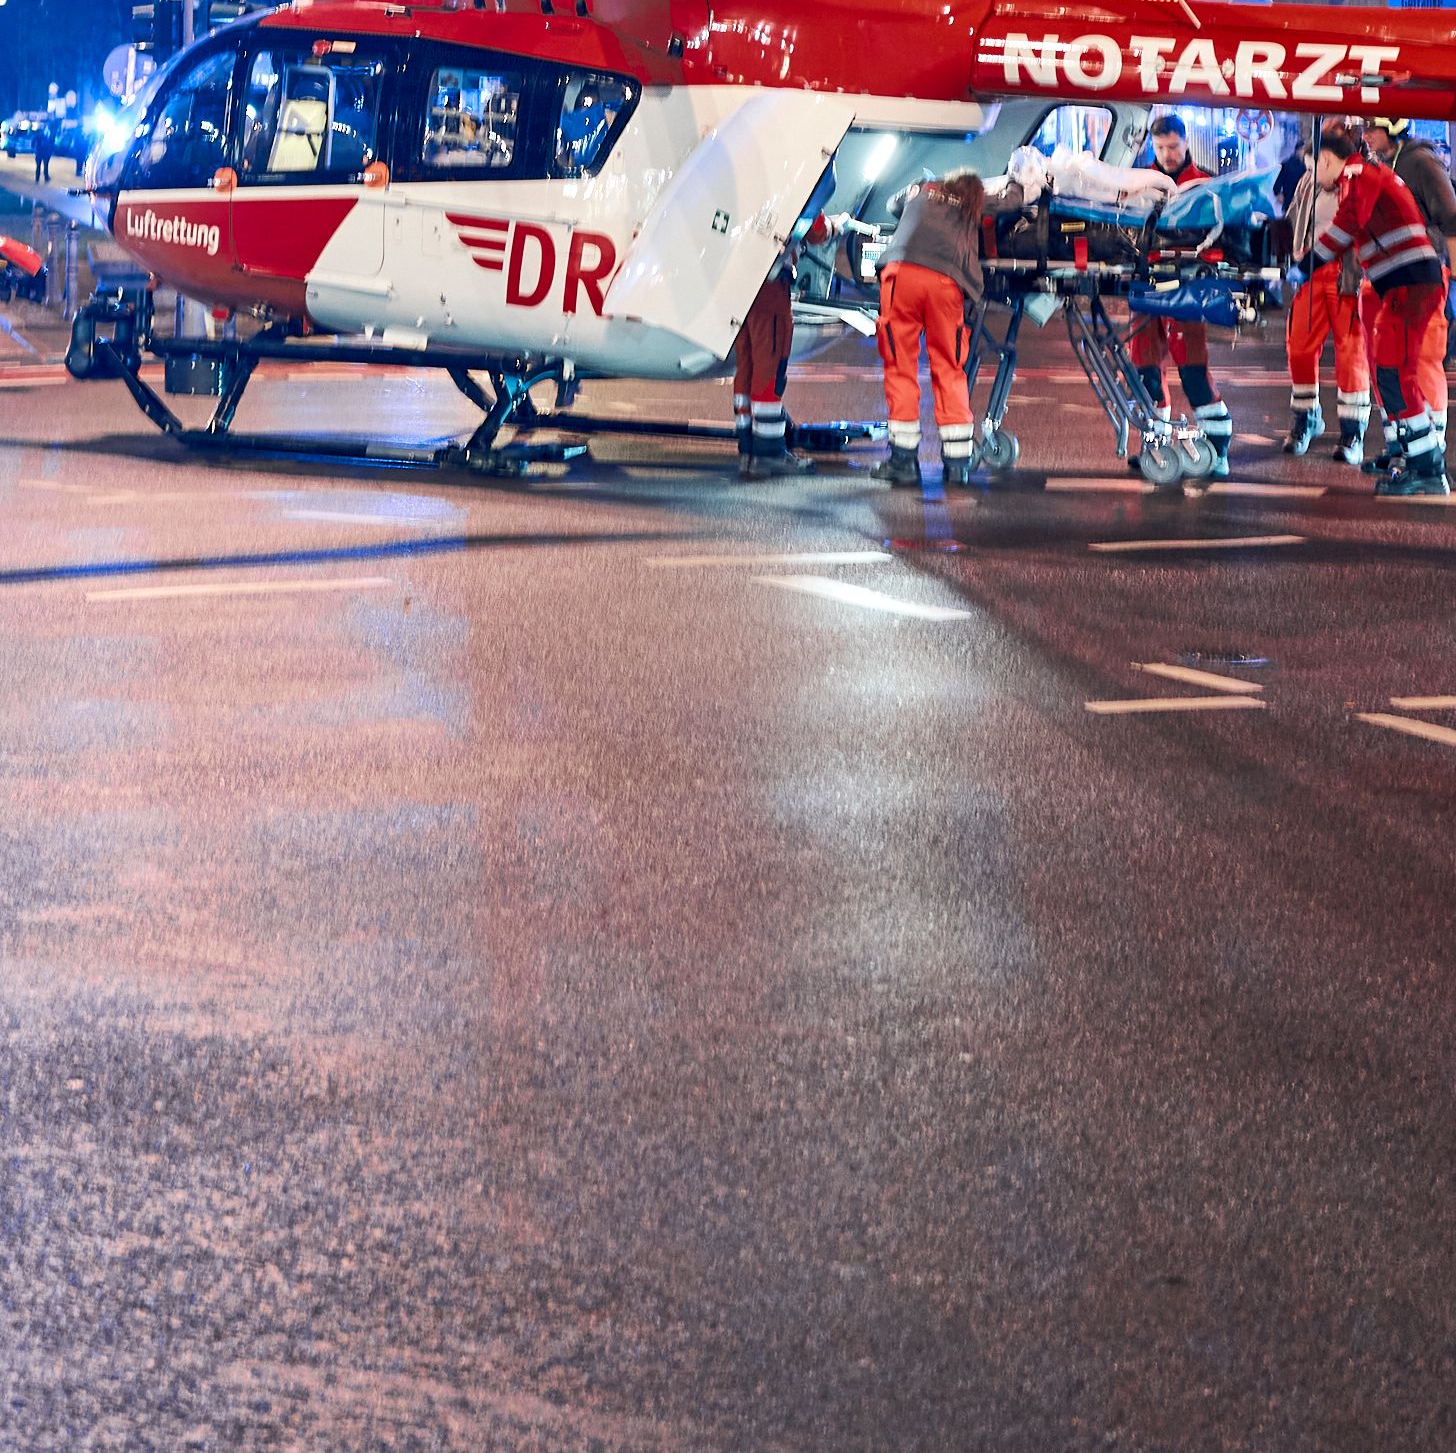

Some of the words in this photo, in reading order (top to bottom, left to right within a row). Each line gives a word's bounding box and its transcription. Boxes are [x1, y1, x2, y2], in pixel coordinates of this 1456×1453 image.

[1003, 31, 1401, 104] NOTARZT
[126, 209, 220, 256] Luftrettung
[506, 221, 618, 317] DR
